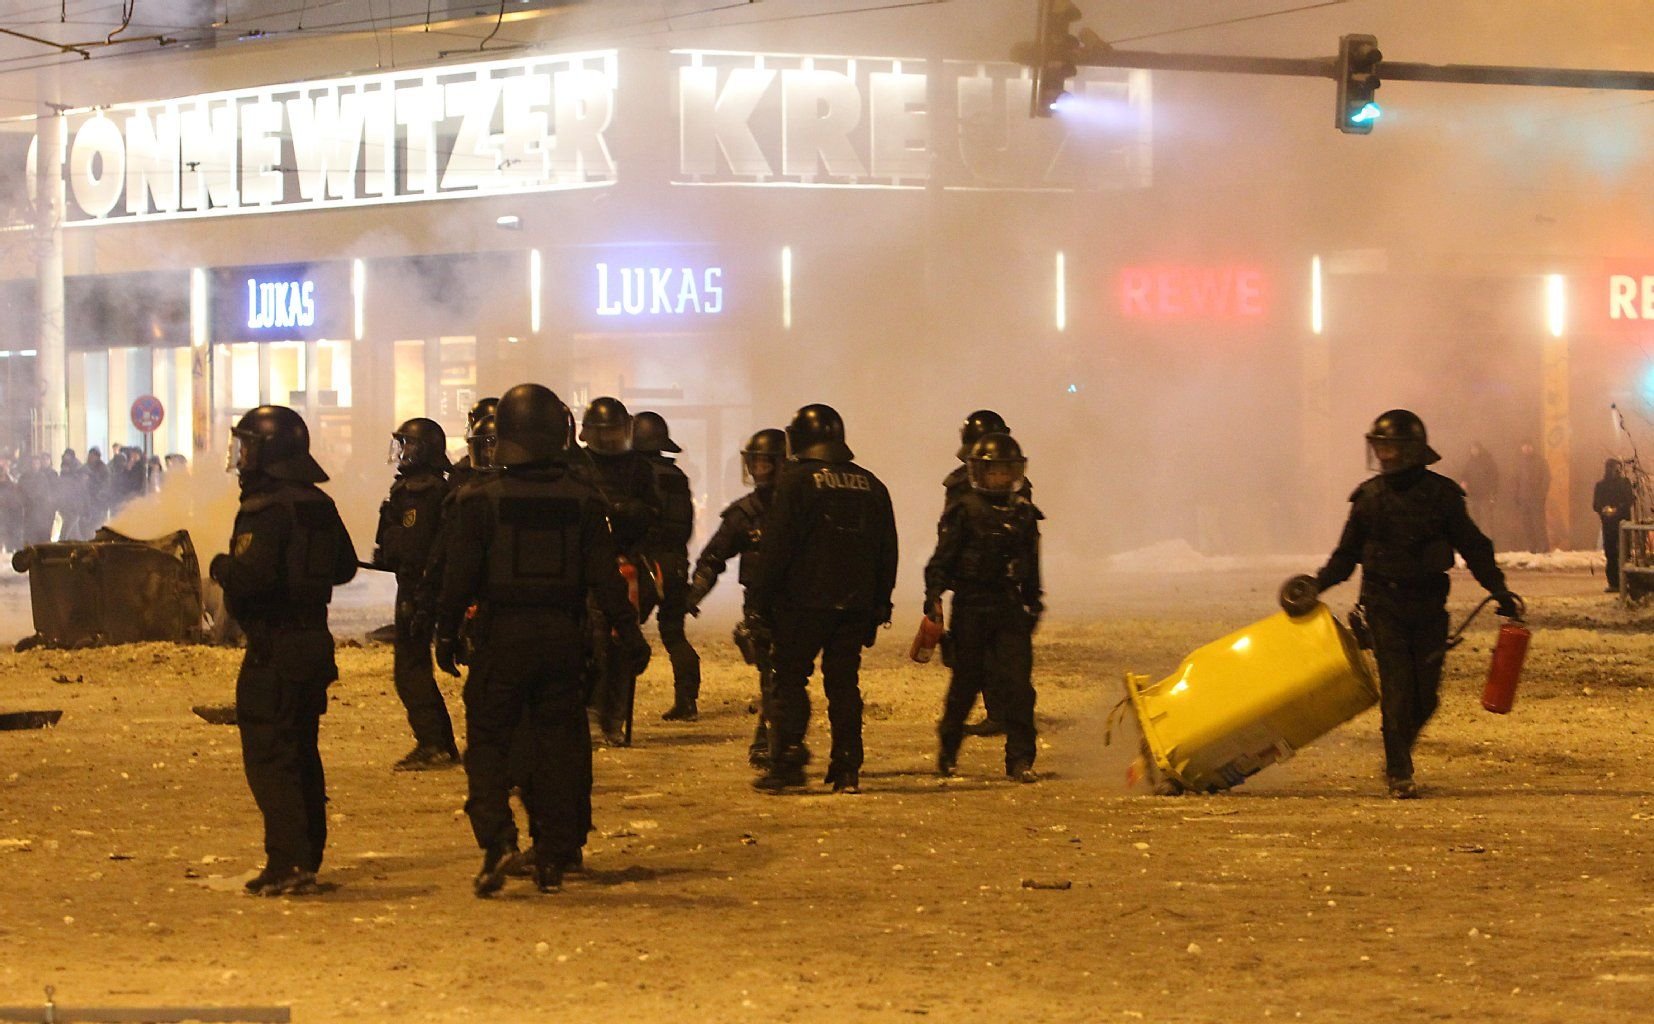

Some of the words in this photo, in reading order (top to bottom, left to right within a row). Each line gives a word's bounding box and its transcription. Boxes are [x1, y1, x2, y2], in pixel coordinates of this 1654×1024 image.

[247, 278, 315, 329] LUKAS
[596, 262, 722, 315] LUKAS
[1122, 267, 1264, 316] REWE
[812, 469, 871, 491] POLIZEI
